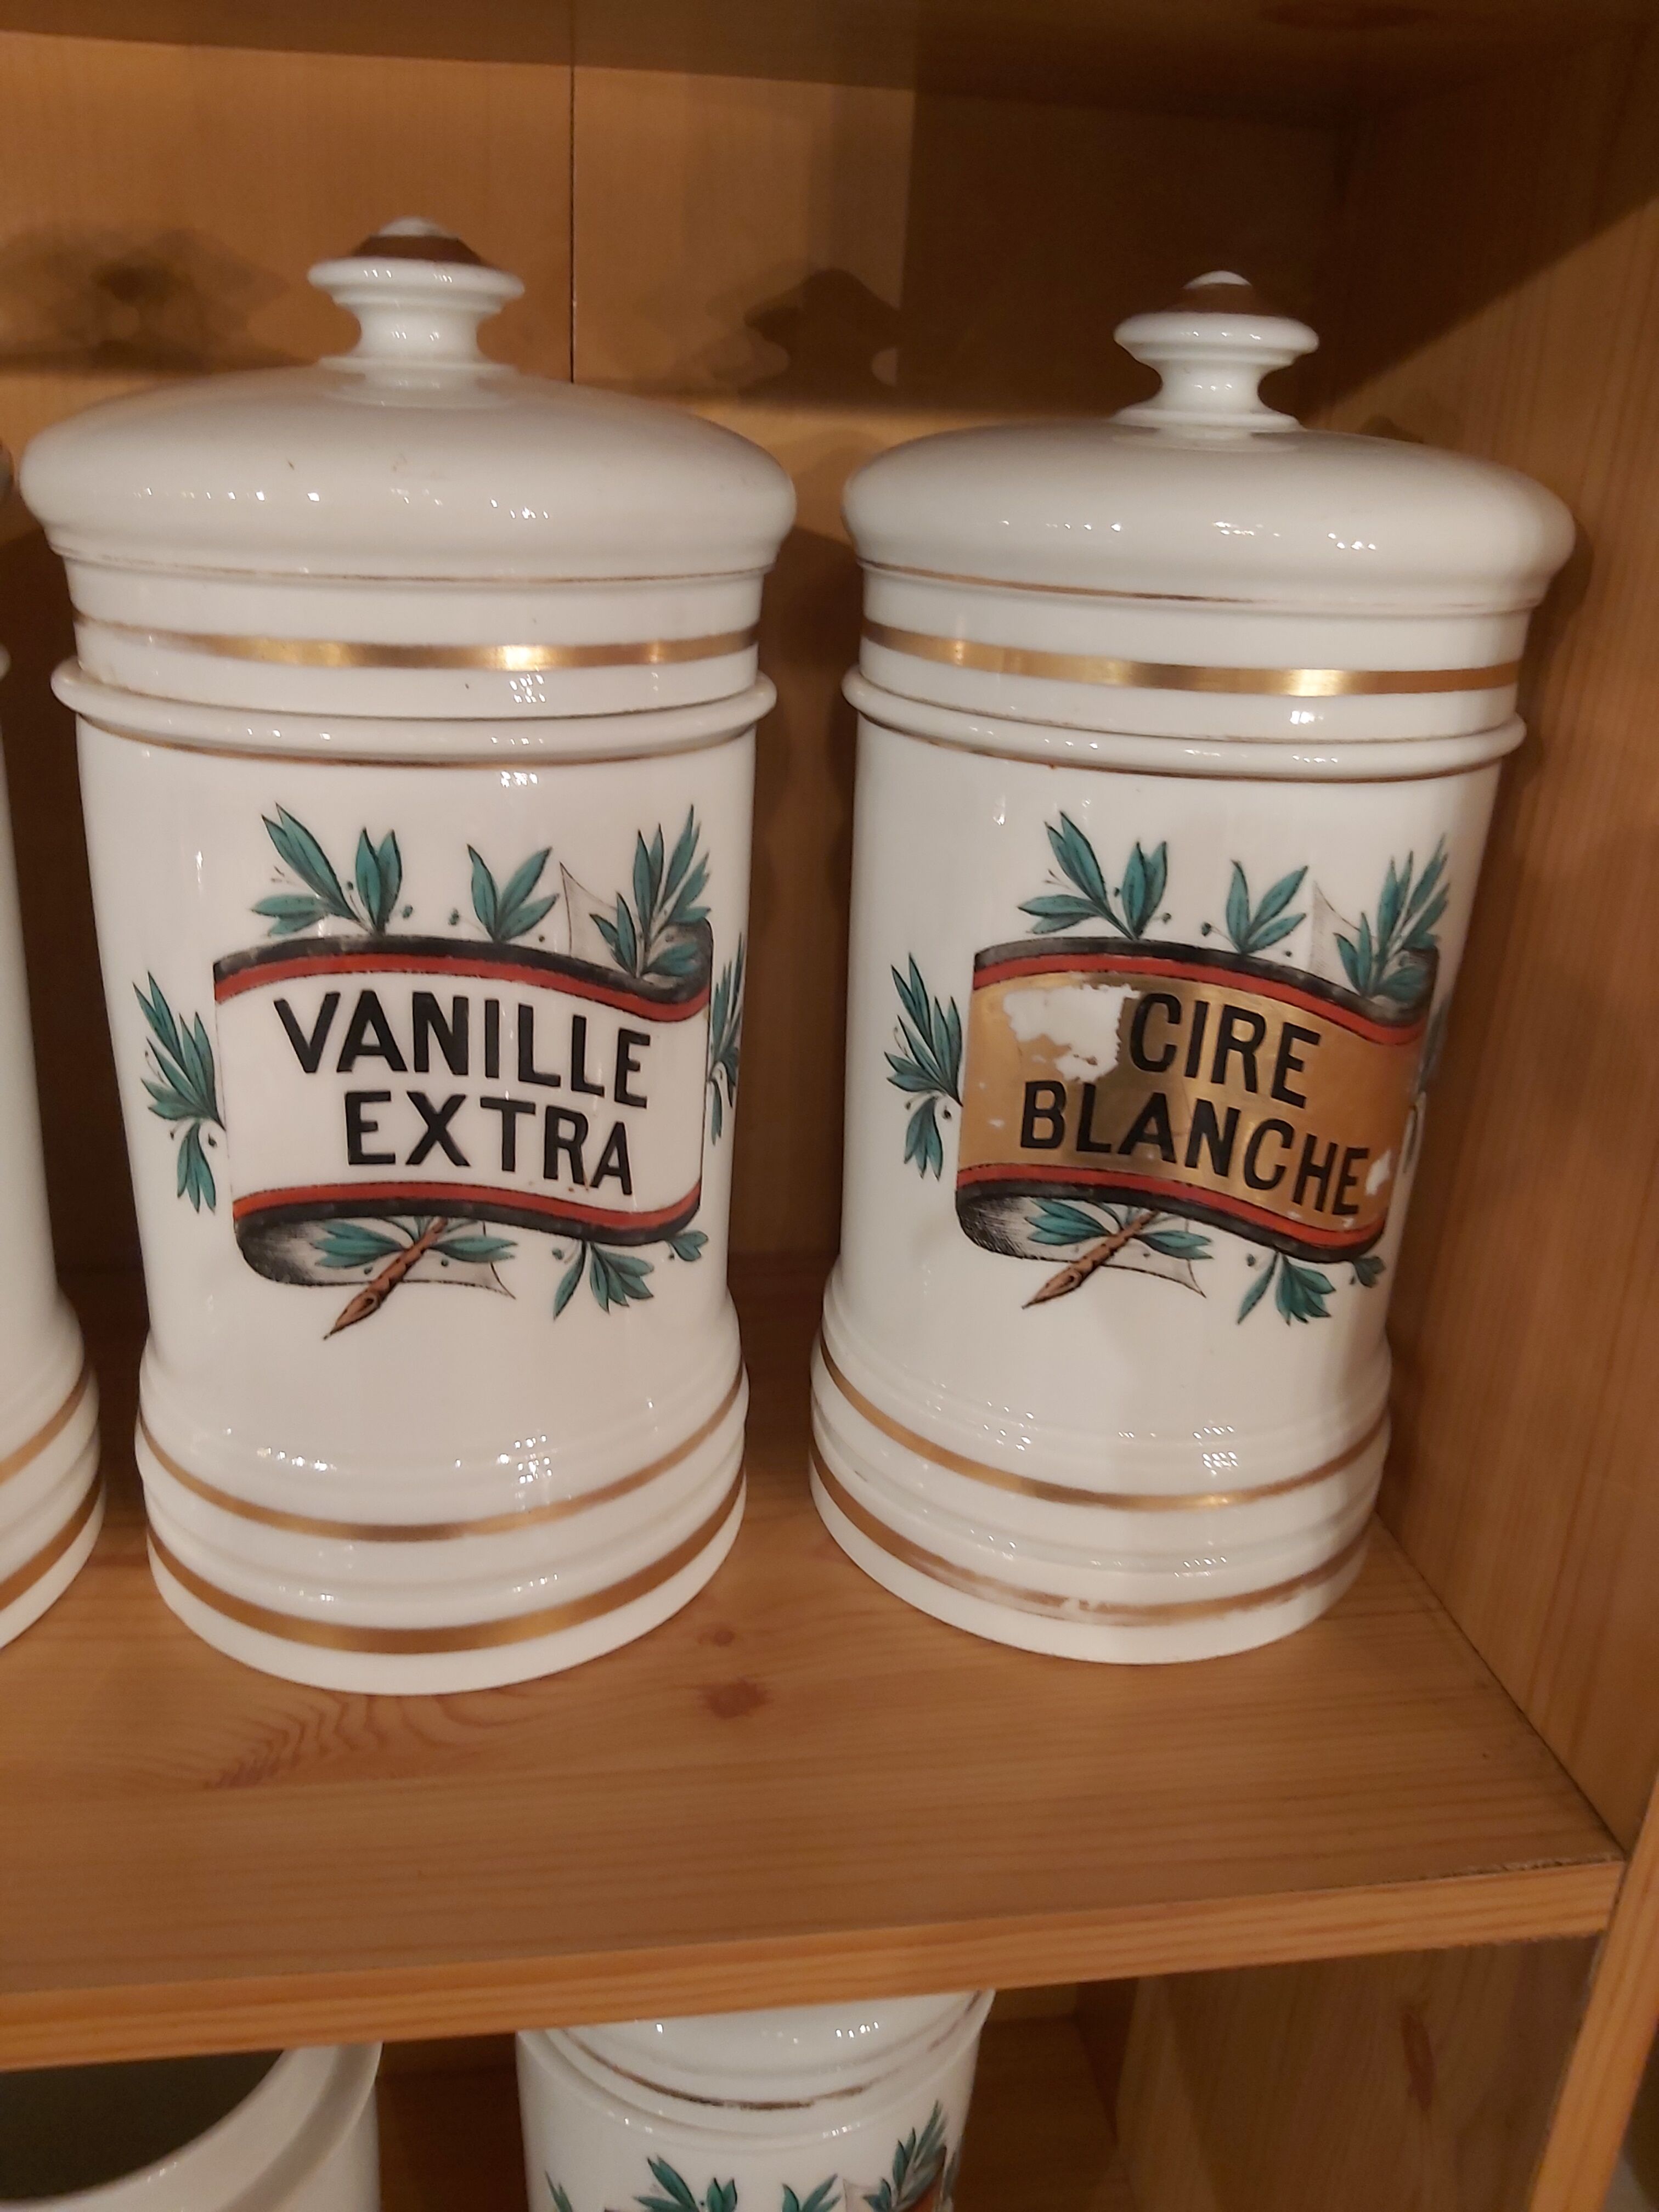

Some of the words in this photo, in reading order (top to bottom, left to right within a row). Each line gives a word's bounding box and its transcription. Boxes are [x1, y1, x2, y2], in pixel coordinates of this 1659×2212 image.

[273, 989, 651, 1109] VANILLE
[1129, 992, 1321, 1109] CIRE
[343, 1090, 633, 1195] EXTRA
[1019, 1080, 1369, 1216] BLANCHE
